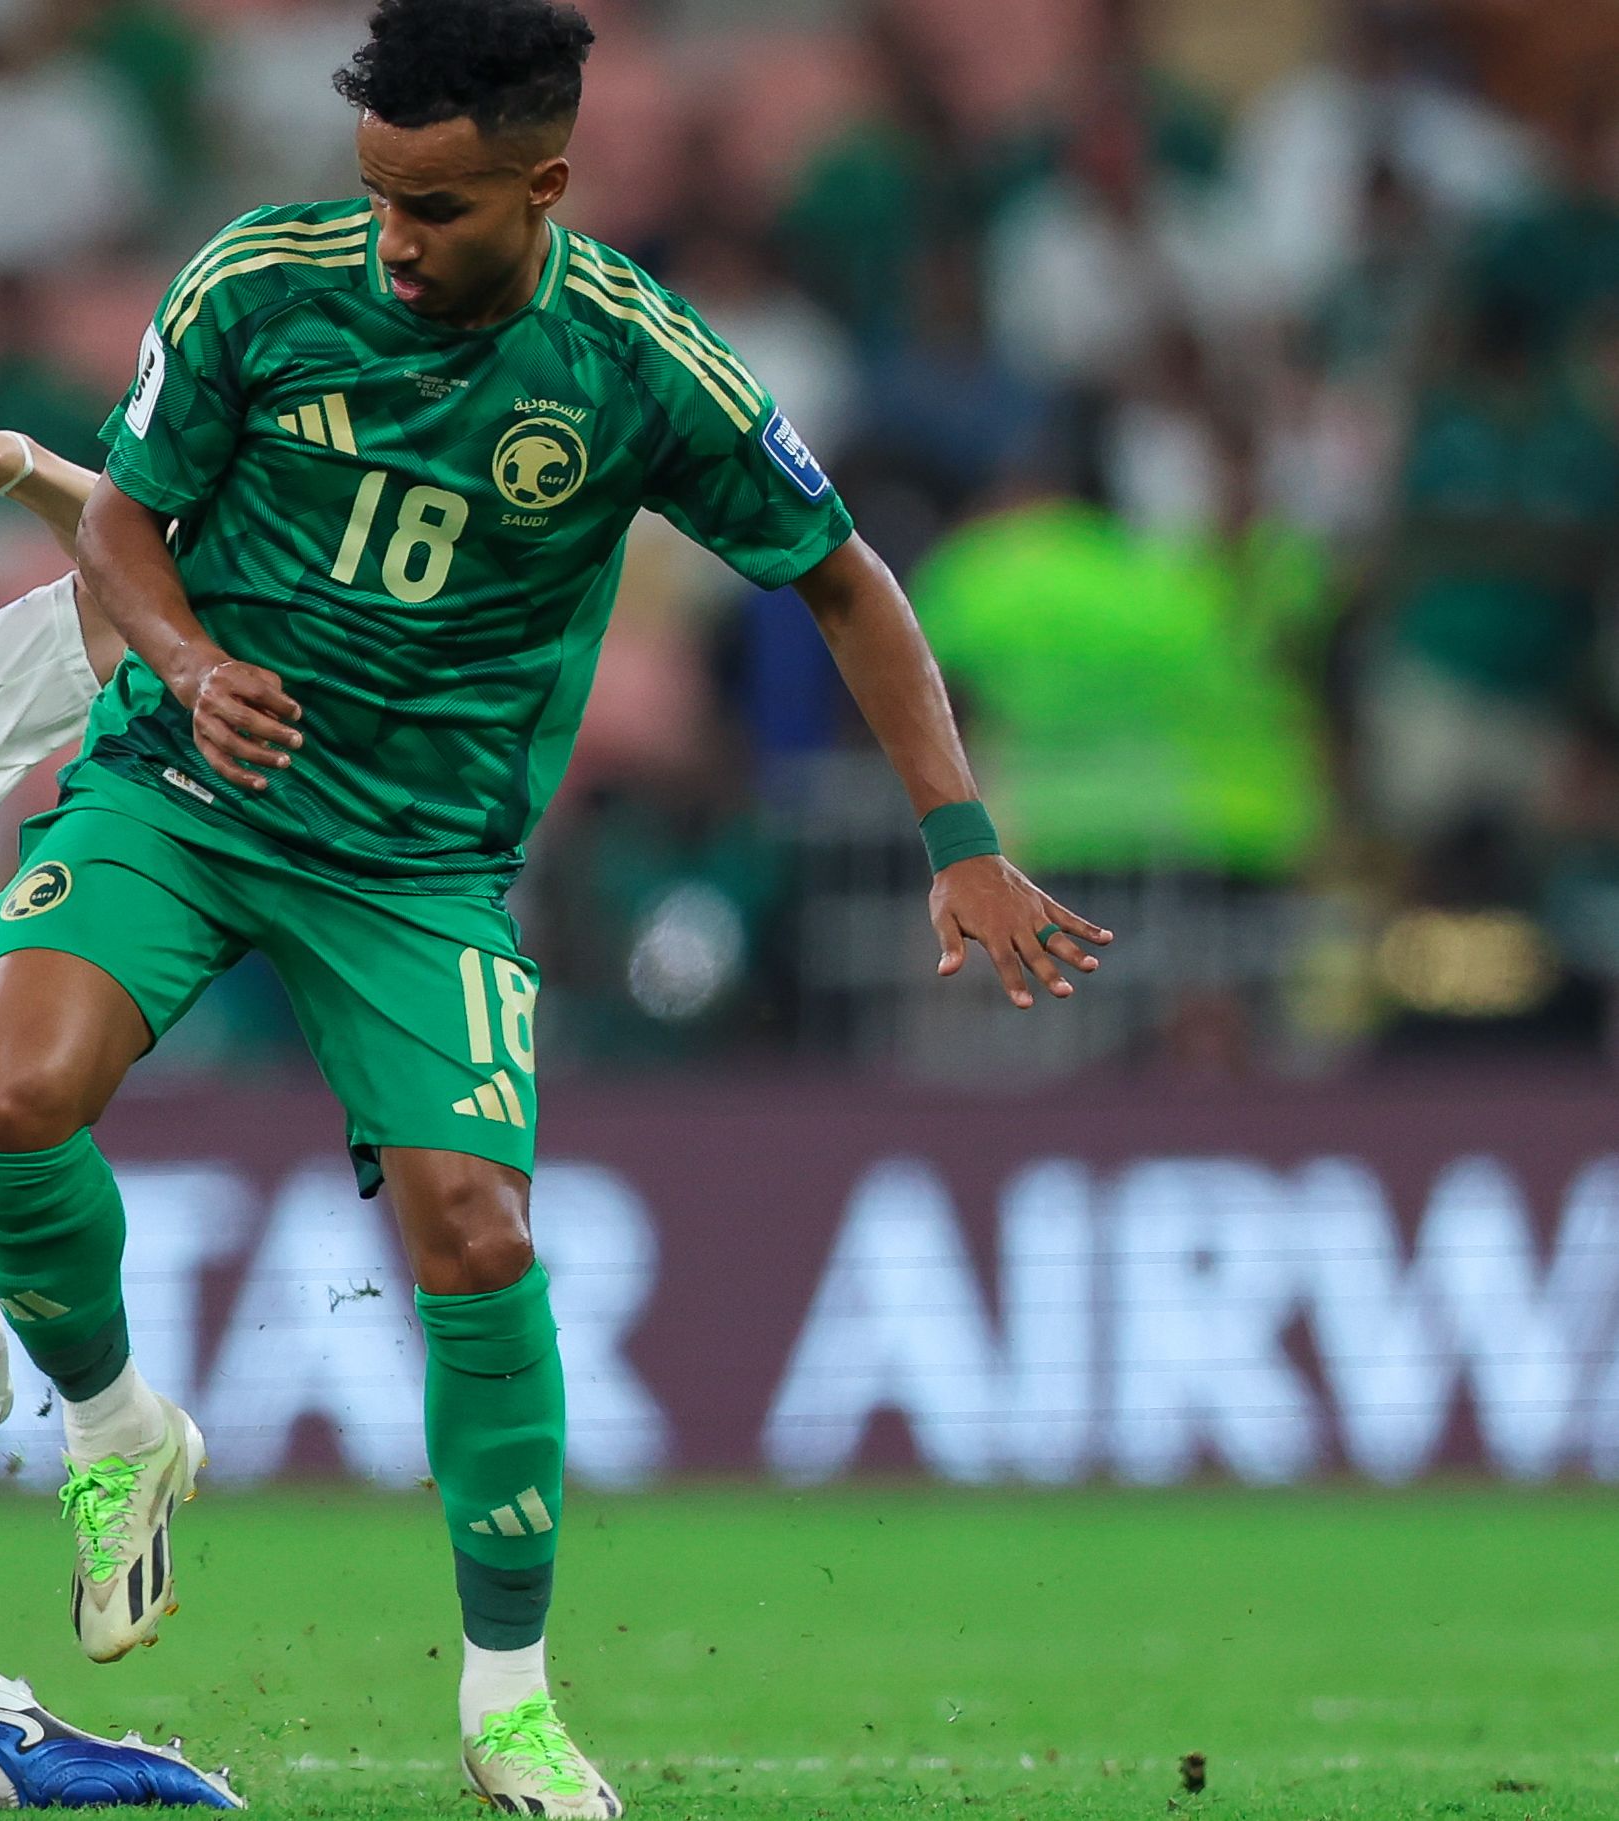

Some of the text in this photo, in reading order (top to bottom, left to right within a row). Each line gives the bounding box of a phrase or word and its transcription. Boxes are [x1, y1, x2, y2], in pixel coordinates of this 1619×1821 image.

[514, 398, 586, 423] السعودية
[539, 475, 566, 485] SAFF
[500, 514, 549, 527] SAUDI
[330, 469, 469, 603] 18
[459, 947, 538, 1075] 18
